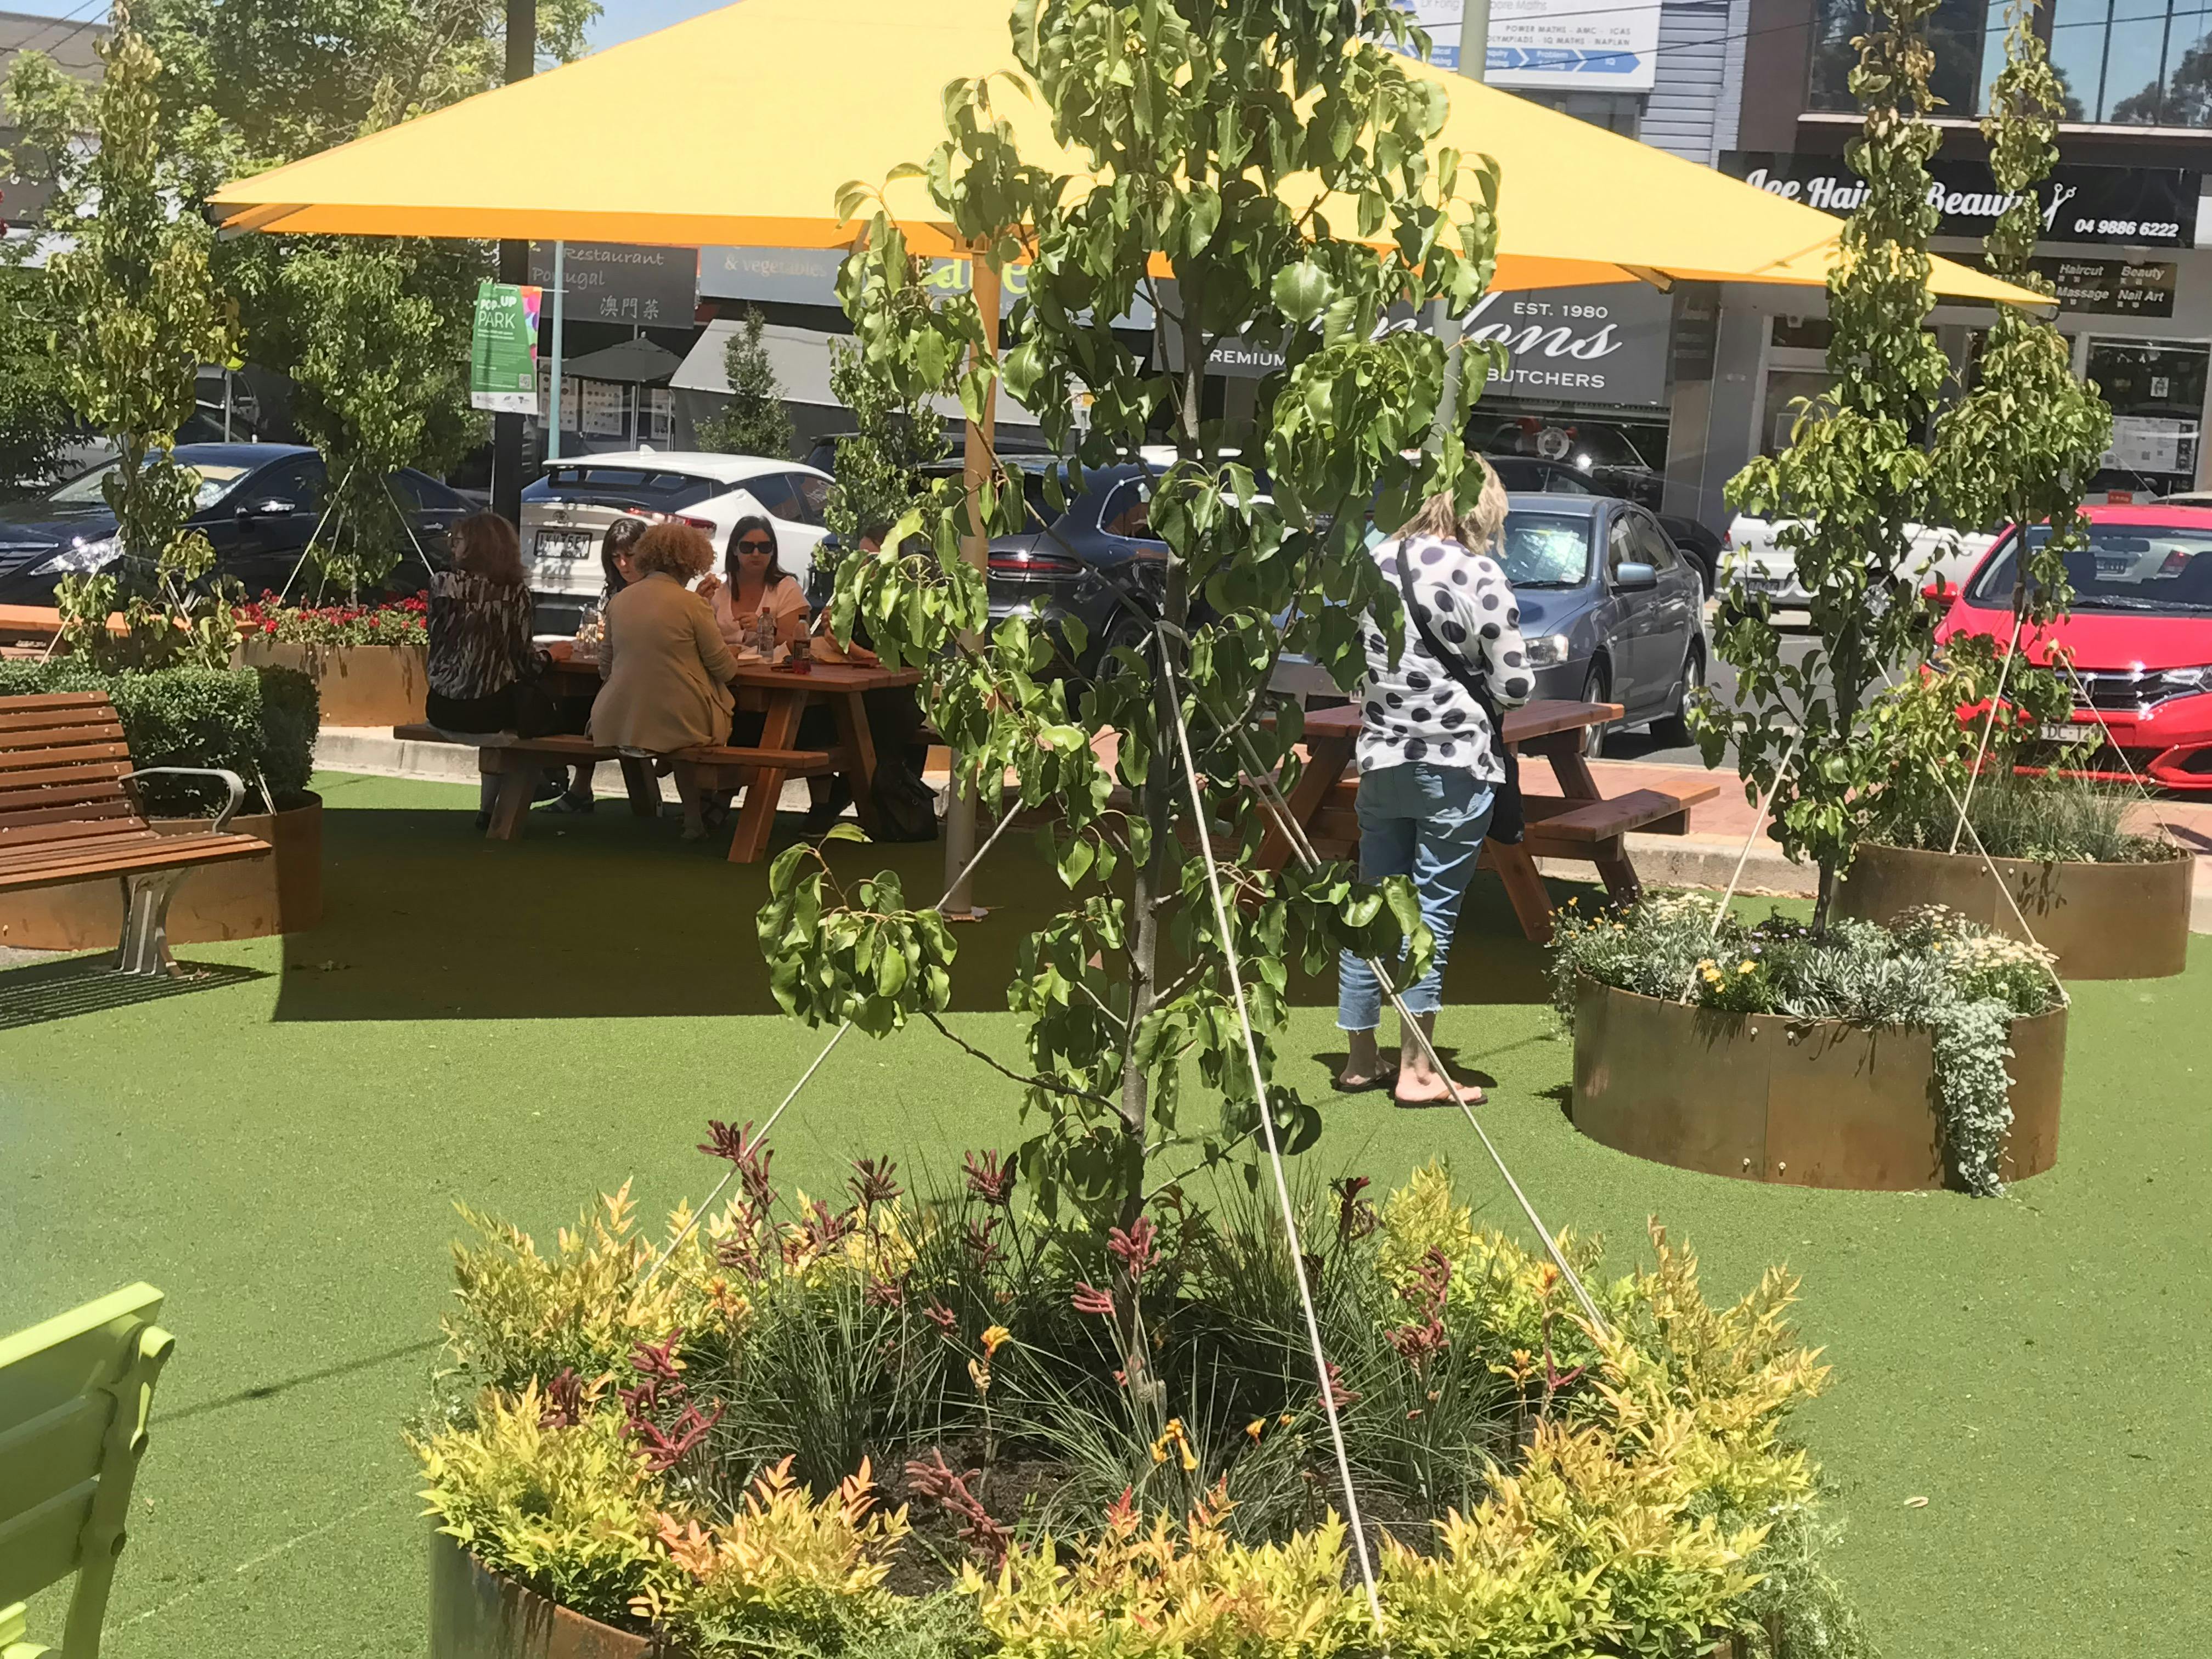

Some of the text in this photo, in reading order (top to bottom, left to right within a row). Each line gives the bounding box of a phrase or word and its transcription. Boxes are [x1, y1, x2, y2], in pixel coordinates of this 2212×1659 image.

[2074, 219, 2179, 237] 04 9886 6222
[564, 248, 664, 265] Restaurant
[532, 267, 606, 290] Pougal
[2059, 264, 2165, 280] Haircut Beauty
[2056, 286, 2164, 302] Massage Nail Art
[1514, 302, 1609, 319] EST. 1980
[478, 311, 516, 329] PARK
[1210, 349, 1285, 366] REMIUM
[1486, 368, 1606, 388] BUTCHERS
